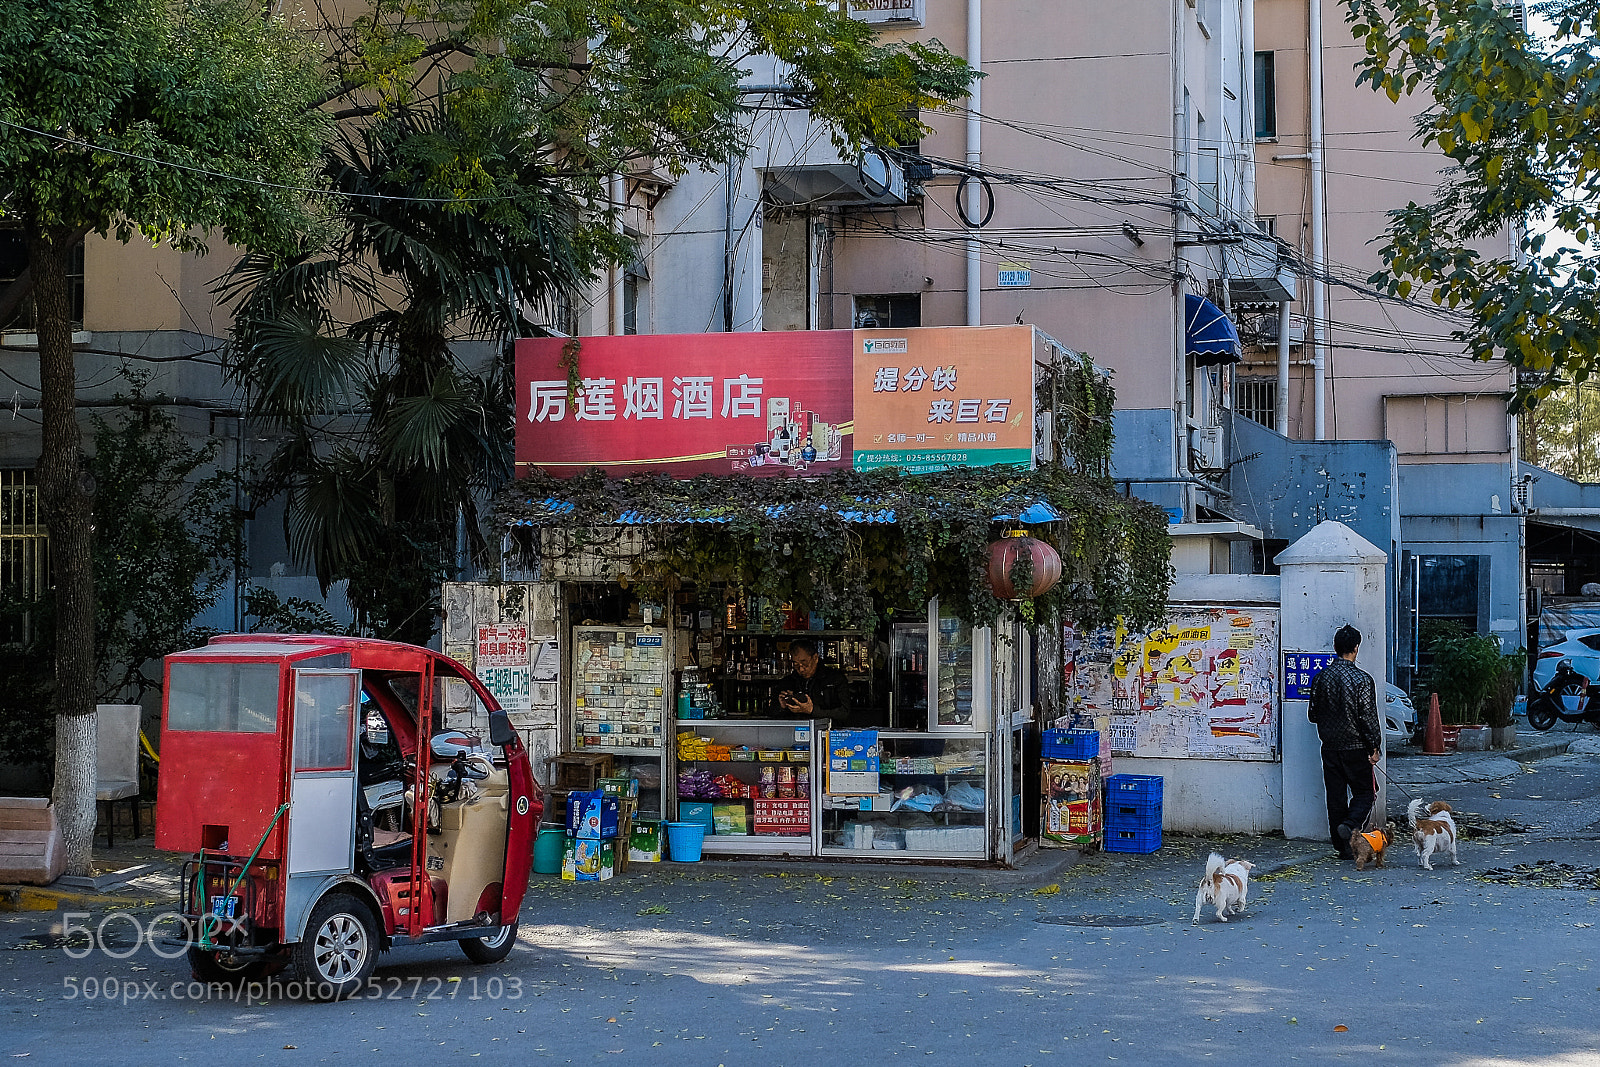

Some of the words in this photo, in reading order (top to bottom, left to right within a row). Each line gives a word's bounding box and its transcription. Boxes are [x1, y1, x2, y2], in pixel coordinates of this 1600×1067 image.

[873, 365, 957, 393] 提分快
[527, 373, 764, 423] 厉莲烟酒店
[927, 399, 1011, 424] 来巨石
[887, 434, 936, 443] 名师一对一
[957, 433, 997, 442] 精品小班
[479, 628, 527, 641] 脚气一次净
[1180, 630, 1209, 640] 加油包
[478, 642, 527, 656] 脚臭脚汗净
[485, 667, 530, 697] 手脚裂口油
[1286, 673, 1310, 686] 预防
